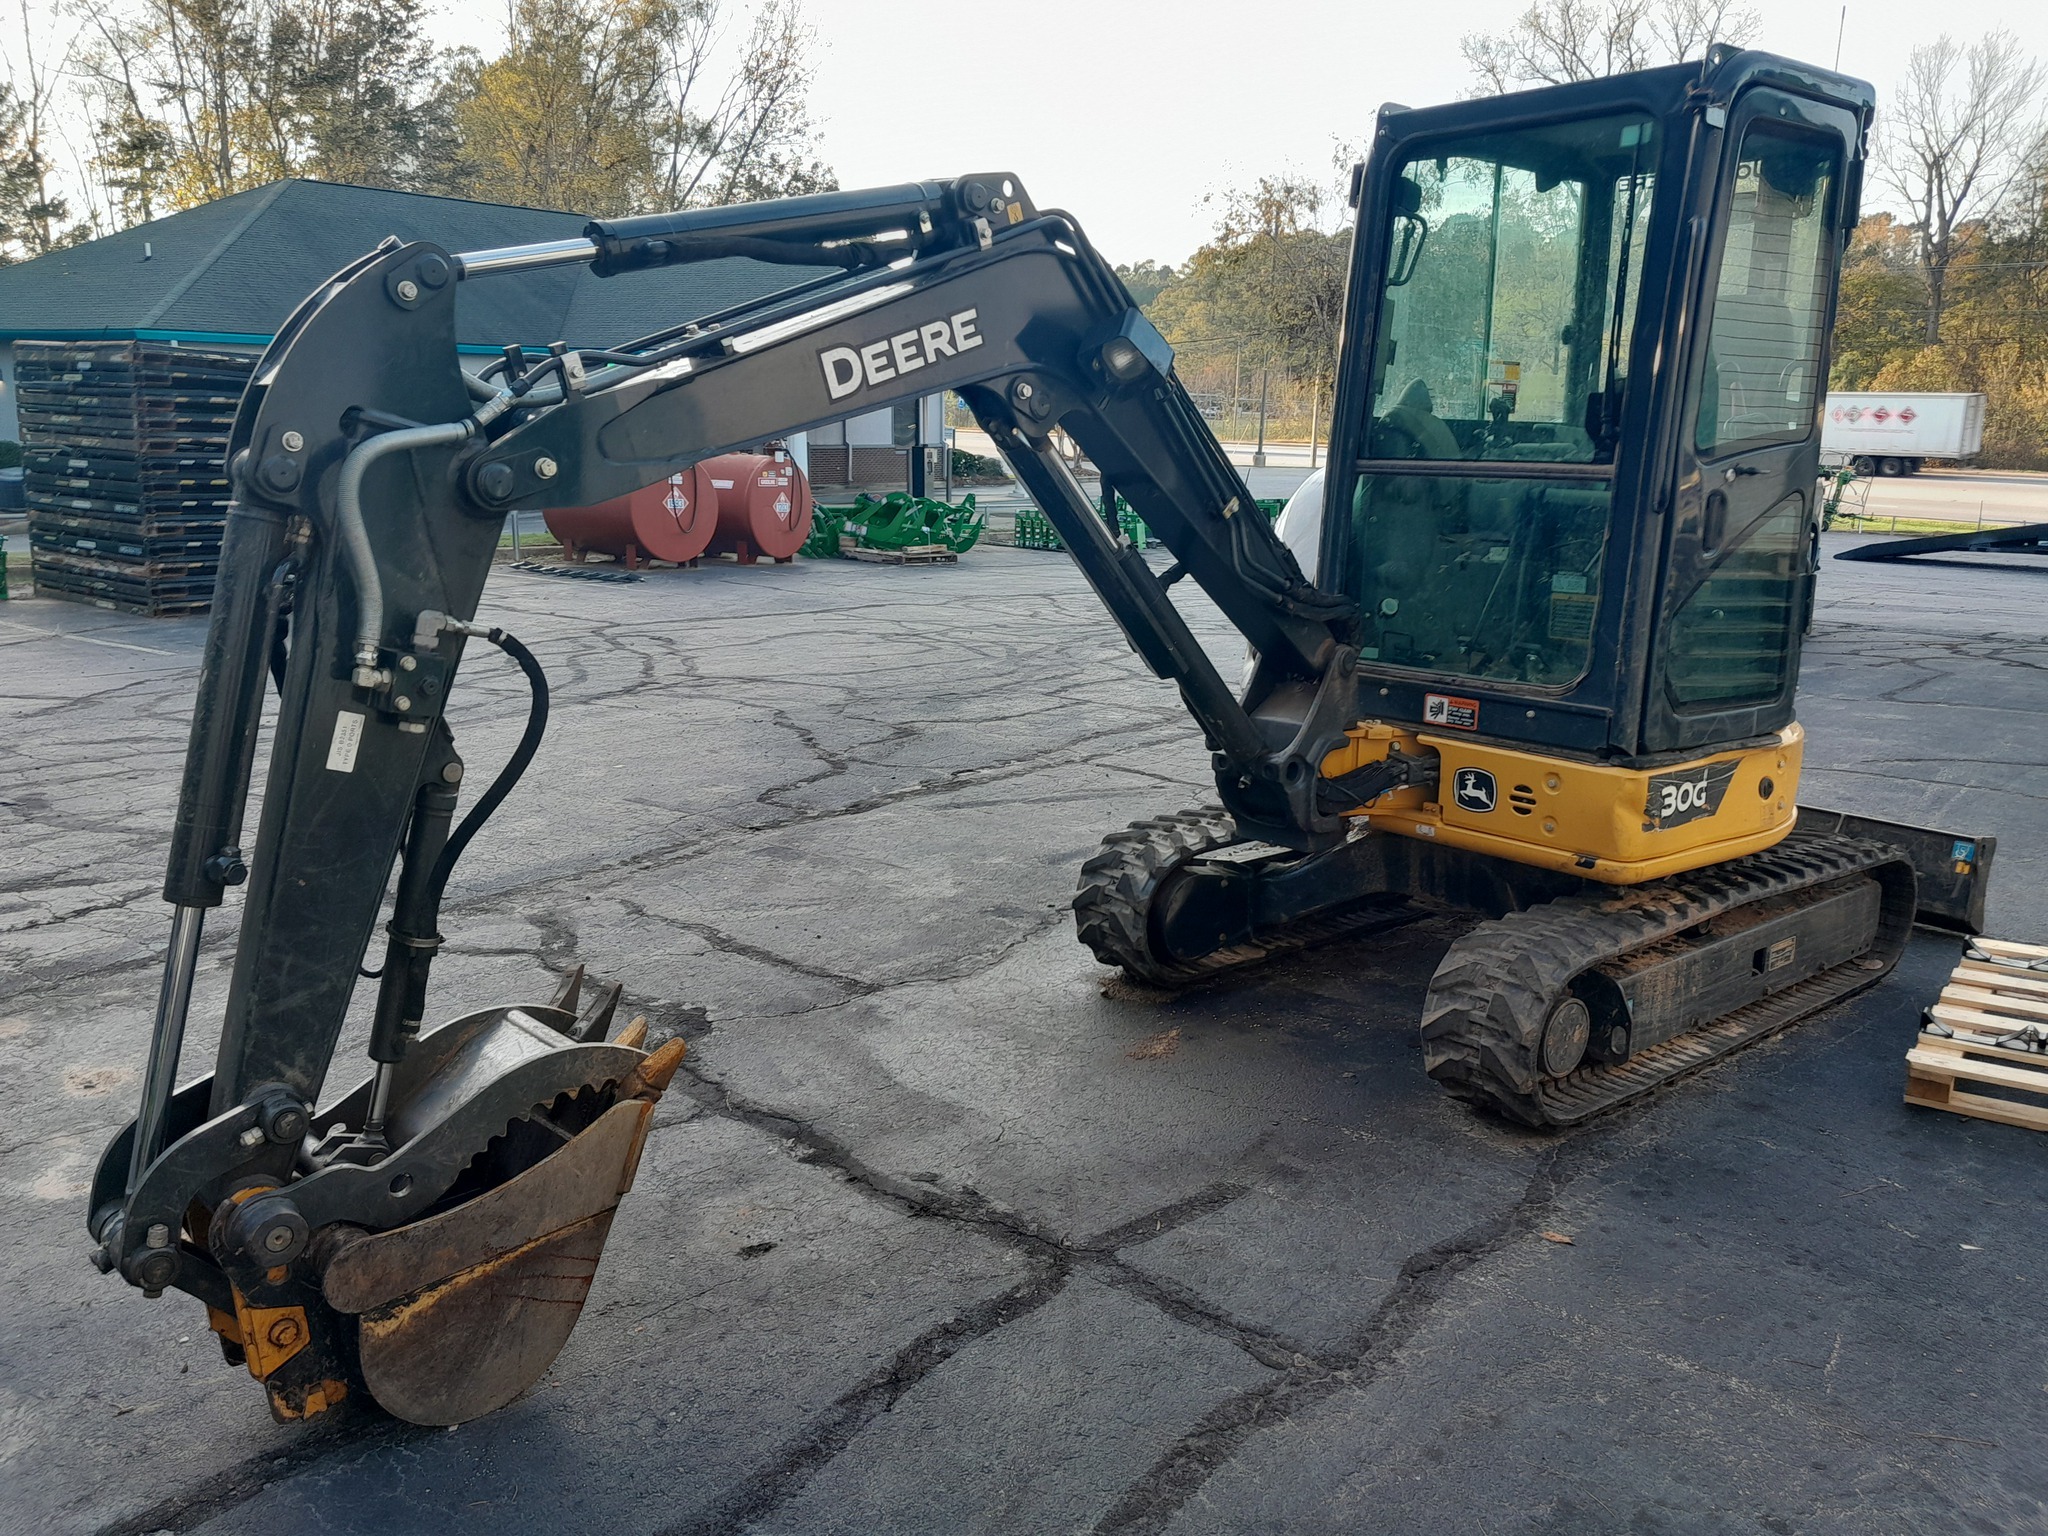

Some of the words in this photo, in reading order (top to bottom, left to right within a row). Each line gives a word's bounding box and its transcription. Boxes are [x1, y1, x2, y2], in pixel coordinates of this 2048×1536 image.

[820, 307, 984, 400] DEERE
[347, 719, 359, 742] PORTS
[1661, 781, 1707, 819] 30G
